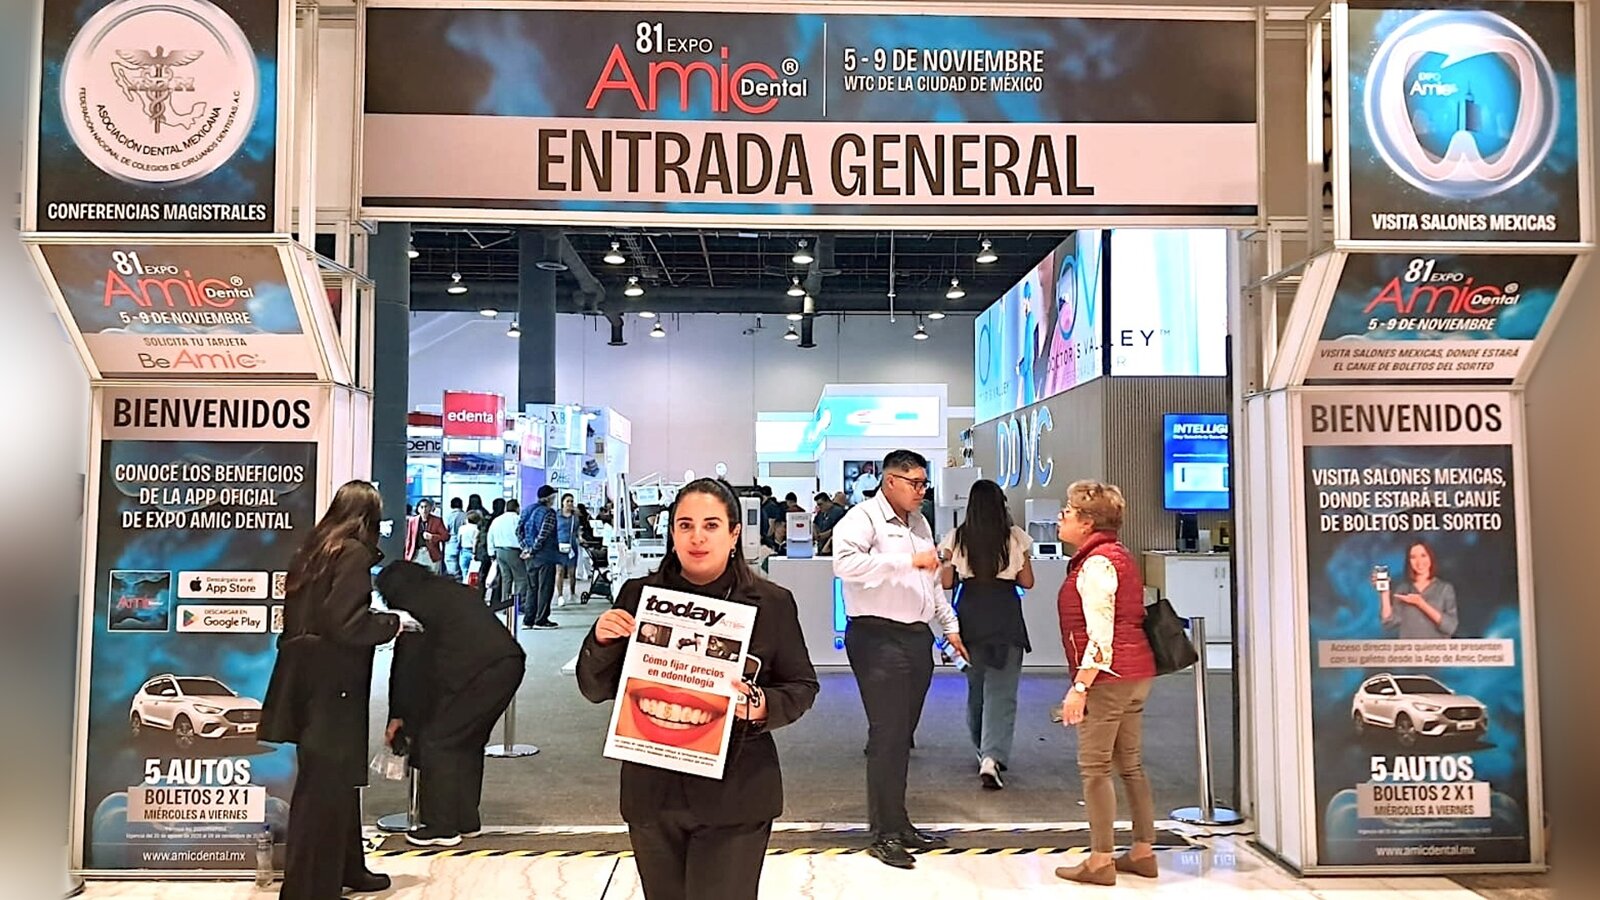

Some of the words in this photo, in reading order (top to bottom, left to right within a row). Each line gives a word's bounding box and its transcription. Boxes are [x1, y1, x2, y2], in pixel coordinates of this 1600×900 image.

[636, 22, 662, 53] 81
[667, 38, 713, 52] EXPO
[844, 48, 856, 71] 5
[874, 49, 886, 72] 9
[892, 49, 918, 72] DE
[923, 50, 1044, 72] NOVIEMBRE
[585, 43, 779, 113] Amic
[741, 78, 807, 97] Dental
[844, 75, 875, 90] WTC
[878, 76, 894, 91] DE
[897, 76, 914, 91] LA
[917, 76, 967, 92] CIUDAD
[970, 76, 988, 92] DE
[990, 73, 1043, 92] MÉXICO
[96, 104, 145, 154] ASOCIACIÓN
[142, 142, 183, 156] DENTAL
[182, 107, 222, 150] MEXICANA
[121, 156, 132, 166] DE
[170, 163, 182, 171] DE
[538, 128, 813, 195] ENTRADA
[830, 133, 1094, 196] GENERAL
[48, 203, 160, 220] CONFERENCIAS
[163, 204, 266, 221] MAGISTRALES
[1372, 213, 1418, 230] VISITA
[1420, 214, 1488, 230] SALONES
[1489, 214, 1556, 231] MEXICAS
[112, 250, 144, 276] 81
[145, 265, 178, 275] EXPO
[1404, 258, 1436, 283] 81
[1430, 272, 1464, 282] EXPO
[103, 269, 236, 308] Amic
[205, 286, 254, 298] Dental
[1364, 277, 1503, 314] Amic
[1470, 294, 1520, 306] Dental
[120, 312, 130, 324] 5
[140, 312, 150, 324] 9
[152, 313, 170, 324] DE
[172, 312, 252, 325] NOVIEMBRE
[1368, 318, 1378, 330] 5
[1386, 318, 1396, 330] 9
[1398, 318, 1416, 330] DE
[1418, 318, 1497, 332] NOVIEMBRE
[144, 337, 189, 347] SOLICITA
[192, 338, 204, 347] TU
[205, 338, 247, 347] TARJETA
[1320, 348, 1350, 358] VISITA
[1352, 348, 1396, 358] SALONES
[1445, 348, 1480, 358] DONDE
[1481, 346, 1520, 358] ESTARÁ
[1333, 362, 1343, 371] EL
[1346, 362, 1376, 371] CANJE
[1378, 362, 1392, 371] DE
[1392, 362, 1435, 371] BOLETOS
[1436, 362, 1454, 371] DEL
[1456, 362, 1494, 371] SORTEO
[114, 398, 311, 429] BIENVENIDOS
[448, 410, 494, 423] edenta
[1311, 403, 1502, 433] BIENVENIDOS
[116, 464, 178, 482] CONOCE
[182, 465, 211, 482] LOS
[214, 465, 304, 482] BENEFICIOS
[1312, 468, 1360, 486] VISITA
[1363, 468, 1430, 486] SALONES
[1434, 468, 1506, 488] MEXICAS,
[140, 488, 160, 504] DE
[162, 488, 181, 504] LA
[184, 488, 216, 505] APP
[220, 488, 278, 506] OFICIAL
[1320, 492, 1370, 508] DONDE
[1375, 487, 1432, 508] ESTARÁ
[1434, 491, 1451, 508] EL
[1454, 490, 1501, 508] CANJE
[122, 512, 143, 528] DE
[146, 512, 186, 528] EXPO
[190, 512, 232, 529] AMIC
[235, 512, 293, 530] DENTAL
[1320, 515, 1340, 532] DE
[1343, 514, 1410, 532] BOLETOS
[1413, 514, 1440, 531] DEL
[1443, 514, 1502, 530] SORTEO
[206, 584, 227, 594] App
[229, 584, 256, 592] Store
[646, 595, 726, 627] today
[204, 616, 239, 628] Google
[241, 617, 261, 628] Play
[670, 659, 689, 672] fijar
[690, 665, 725, 678] precios
[145, 759, 160, 784] 5
[166, 759, 250, 785] AUTOS
[1371, 756, 1387, 782] 5
[1393, 756, 1474, 782] AUTOS
[145, 789, 211, 805] BOLETOS
[216, 790, 225, 804] 2
[229, 790, 239, 805] X
[242, 790, 248, 805] 1
[1374, 786, 1438, 801] BOLETOS
[1441, 786, 1450, 801] 2
[1454, 786, 1464, 800] X
[1468, 786, 1474, 800] 1
[144, 806, 197, 820] MIÉRCOLES
[200, 810, 206, 820] A
[208, 810, 248, 820] VIERNES
[1374, 803, 1424, 816] MIÉRCOLES
[1428, 806, 1435, 816] A
[1435, 805, 1474, 816] VIERNES
[143, 850, 246, 861] www.amicdental.mx
[1376, 846, 1476, 856] www.amicdental.mx
